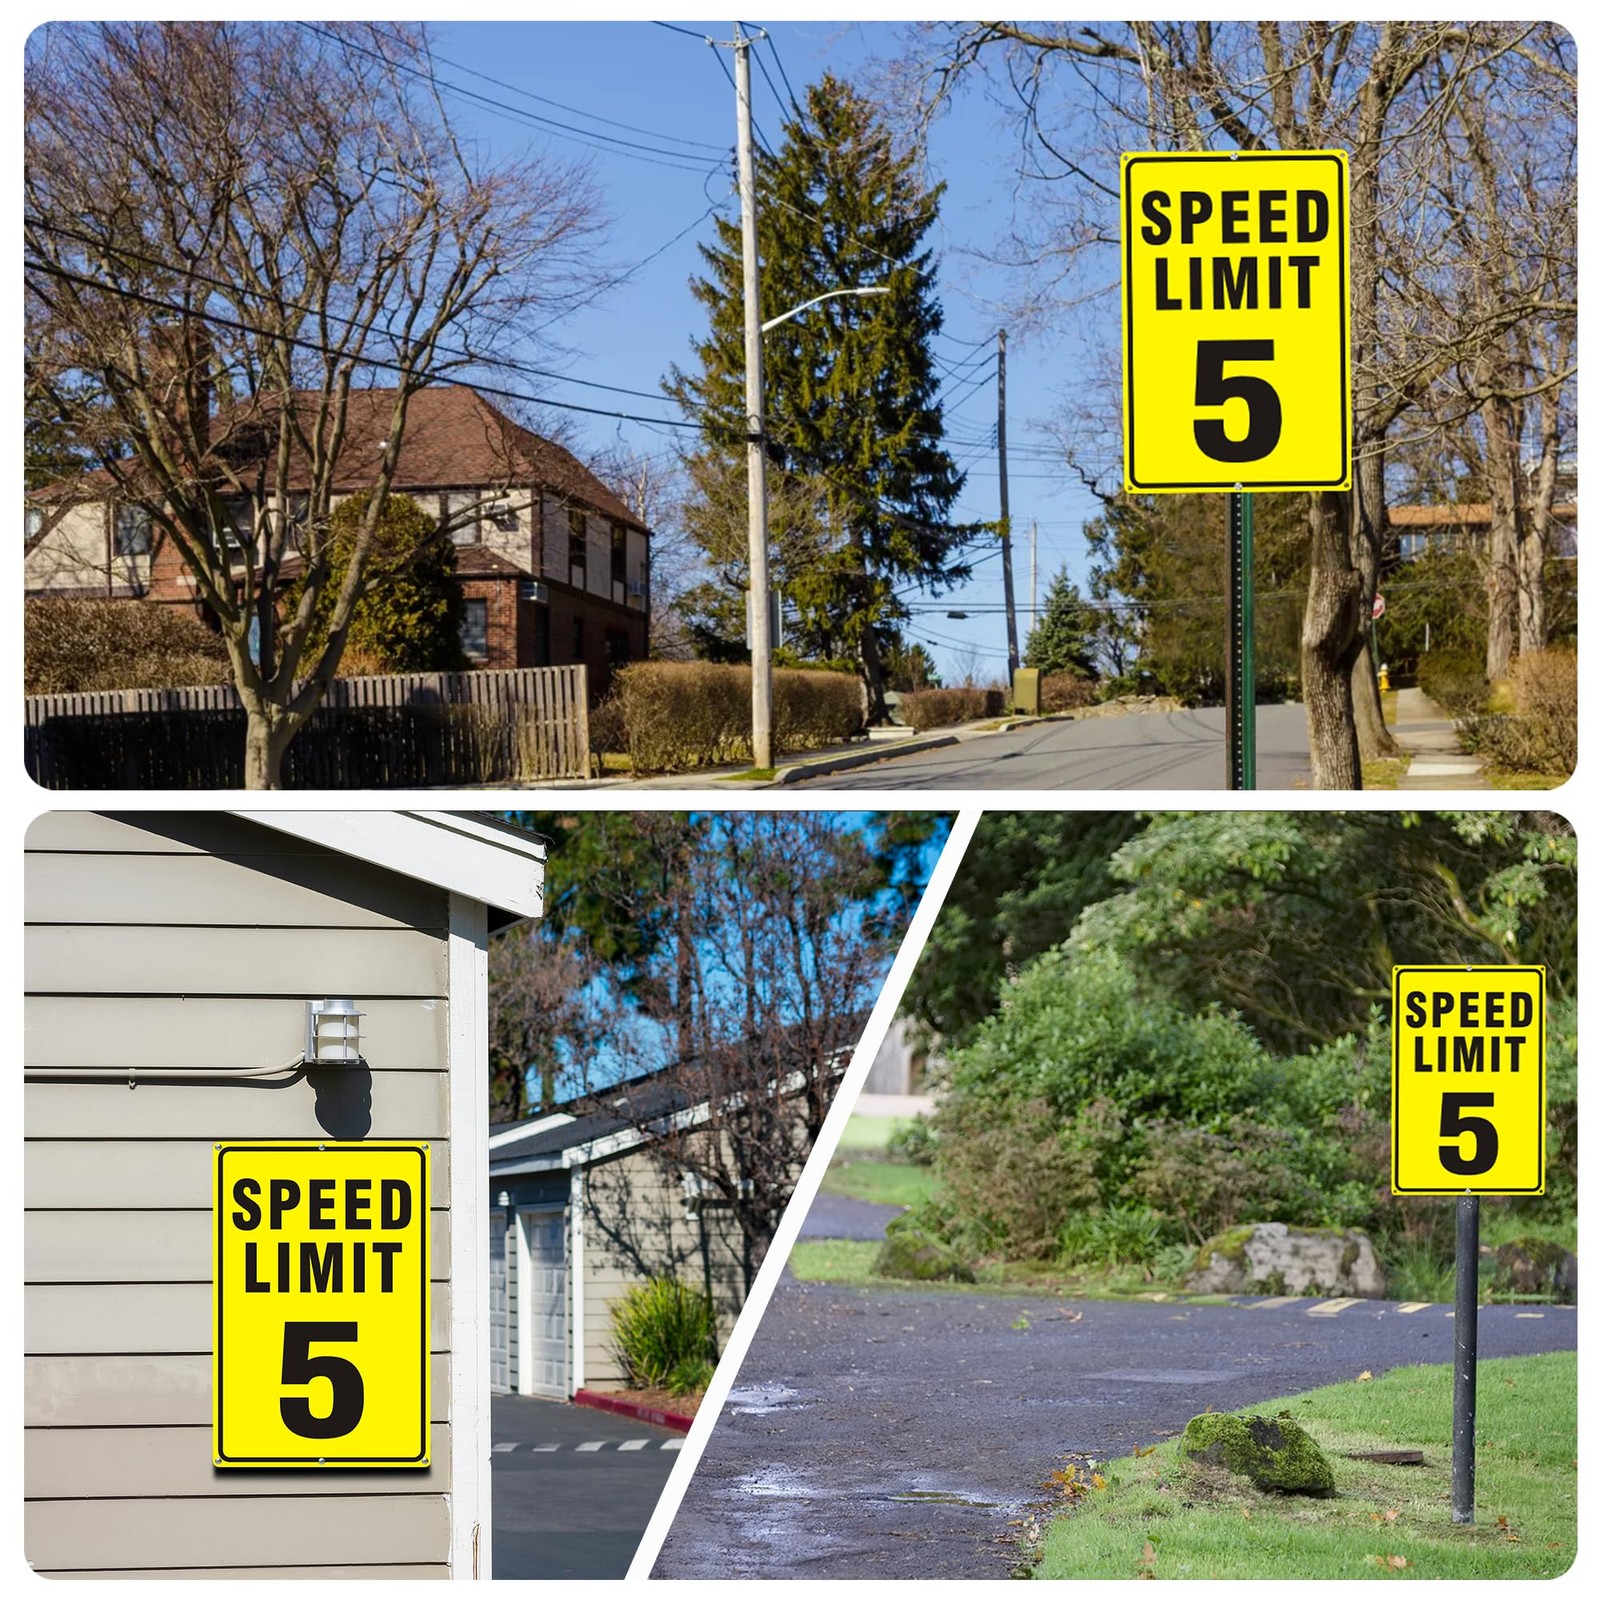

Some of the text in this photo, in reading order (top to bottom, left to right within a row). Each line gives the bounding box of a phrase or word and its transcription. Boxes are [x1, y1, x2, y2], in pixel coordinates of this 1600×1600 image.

[1141, 190, 1329, 246] SPEED
[1155, 256, 1320, 311] LIMIT
[1193, 340, 1282, 463] 5
[1405, 991, 1533, 1028] SPEED
[1414, 1037, 1527, 1073] LIMIT
[1438, 1092, 1499, 1175] 5
[232, 1178, 412, 1231] SPEED
[245, 1243, 403, 1293] LIMIT
[279, 1322, 365, 1440] 5
